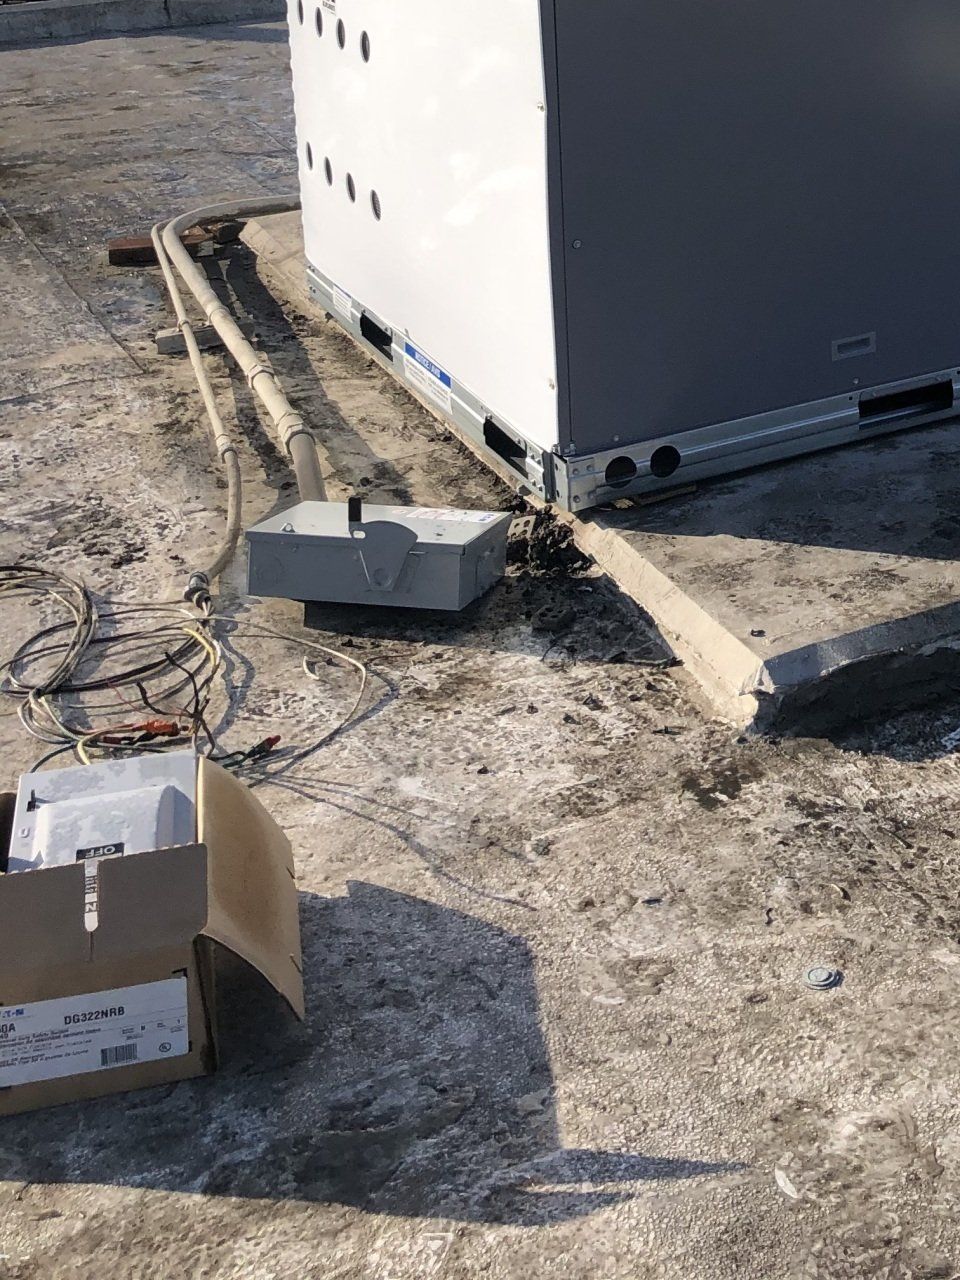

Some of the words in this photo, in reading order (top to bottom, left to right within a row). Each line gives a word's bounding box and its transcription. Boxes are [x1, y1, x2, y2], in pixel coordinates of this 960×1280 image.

[85, 845, 116, 858] OFF
[64, 1006, 125, 1025] DG322NRB
[0, 1022, 16, 1033] 0A
